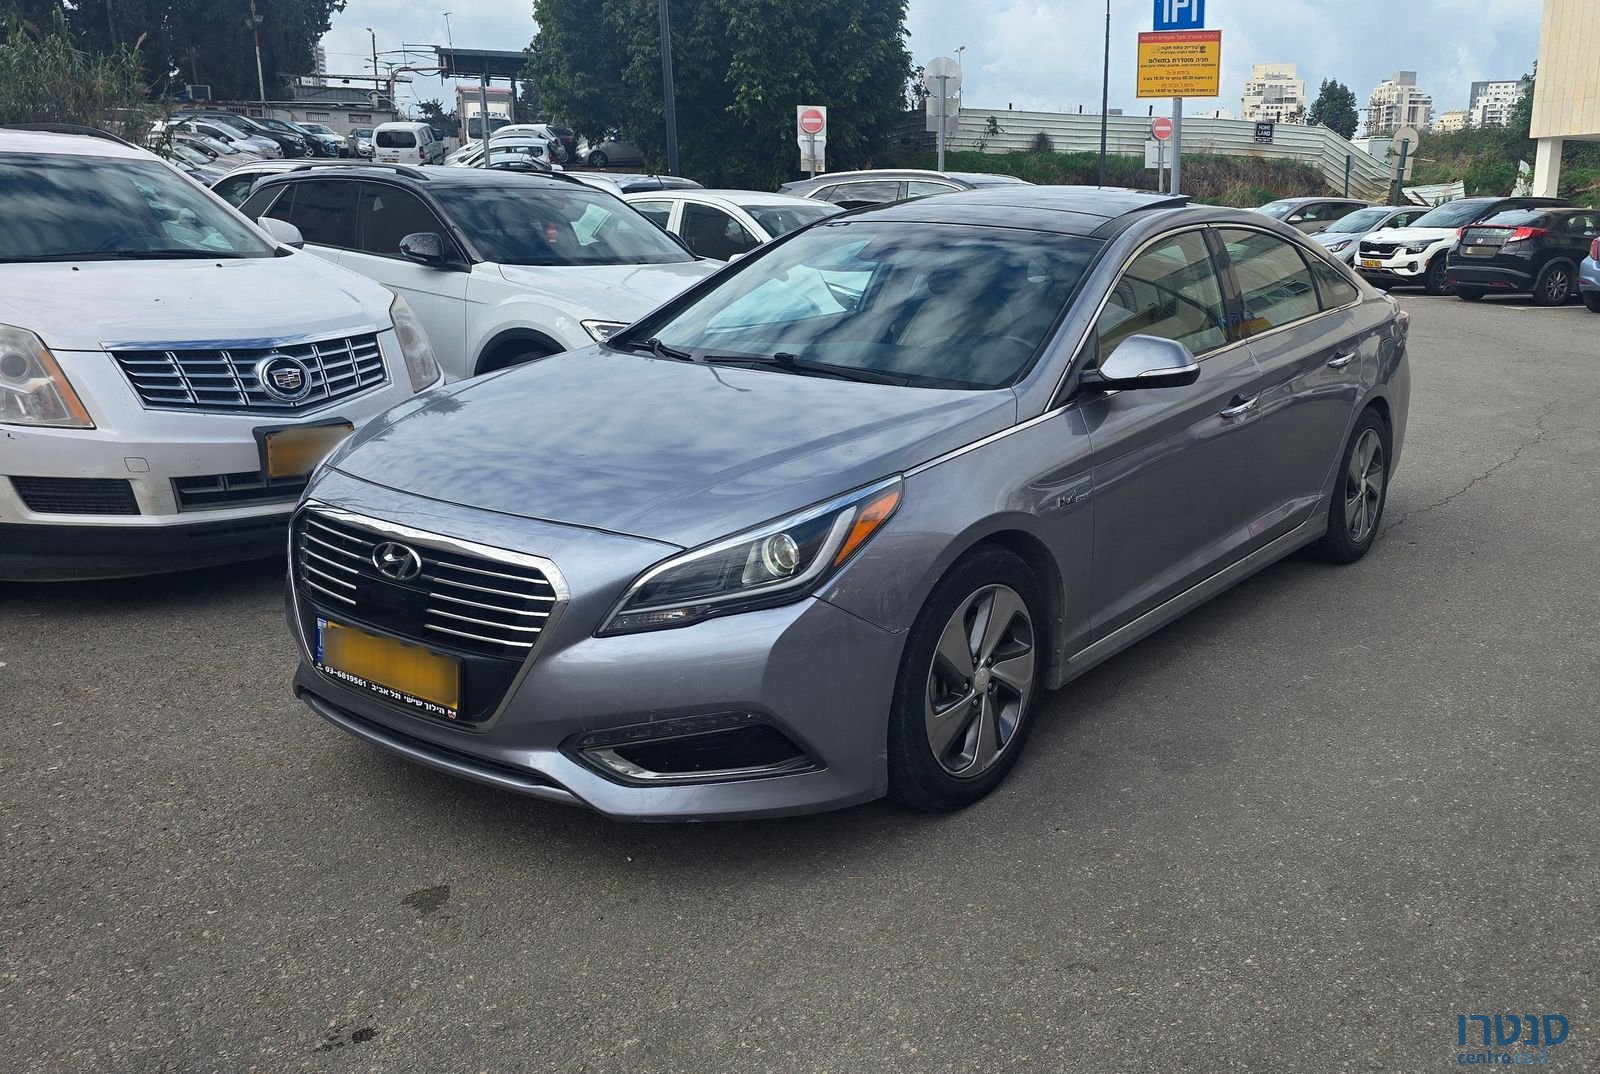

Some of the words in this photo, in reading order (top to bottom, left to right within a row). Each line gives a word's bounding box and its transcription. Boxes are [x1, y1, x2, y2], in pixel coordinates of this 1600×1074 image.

[325, 665, 367, 688] 03-6819561
[371, 684, 389, 696] אביב
[390, 689, 401, 700] תל
[403, 695, 424, 706] שישי
[424, 702, 446, 715] הילוך
